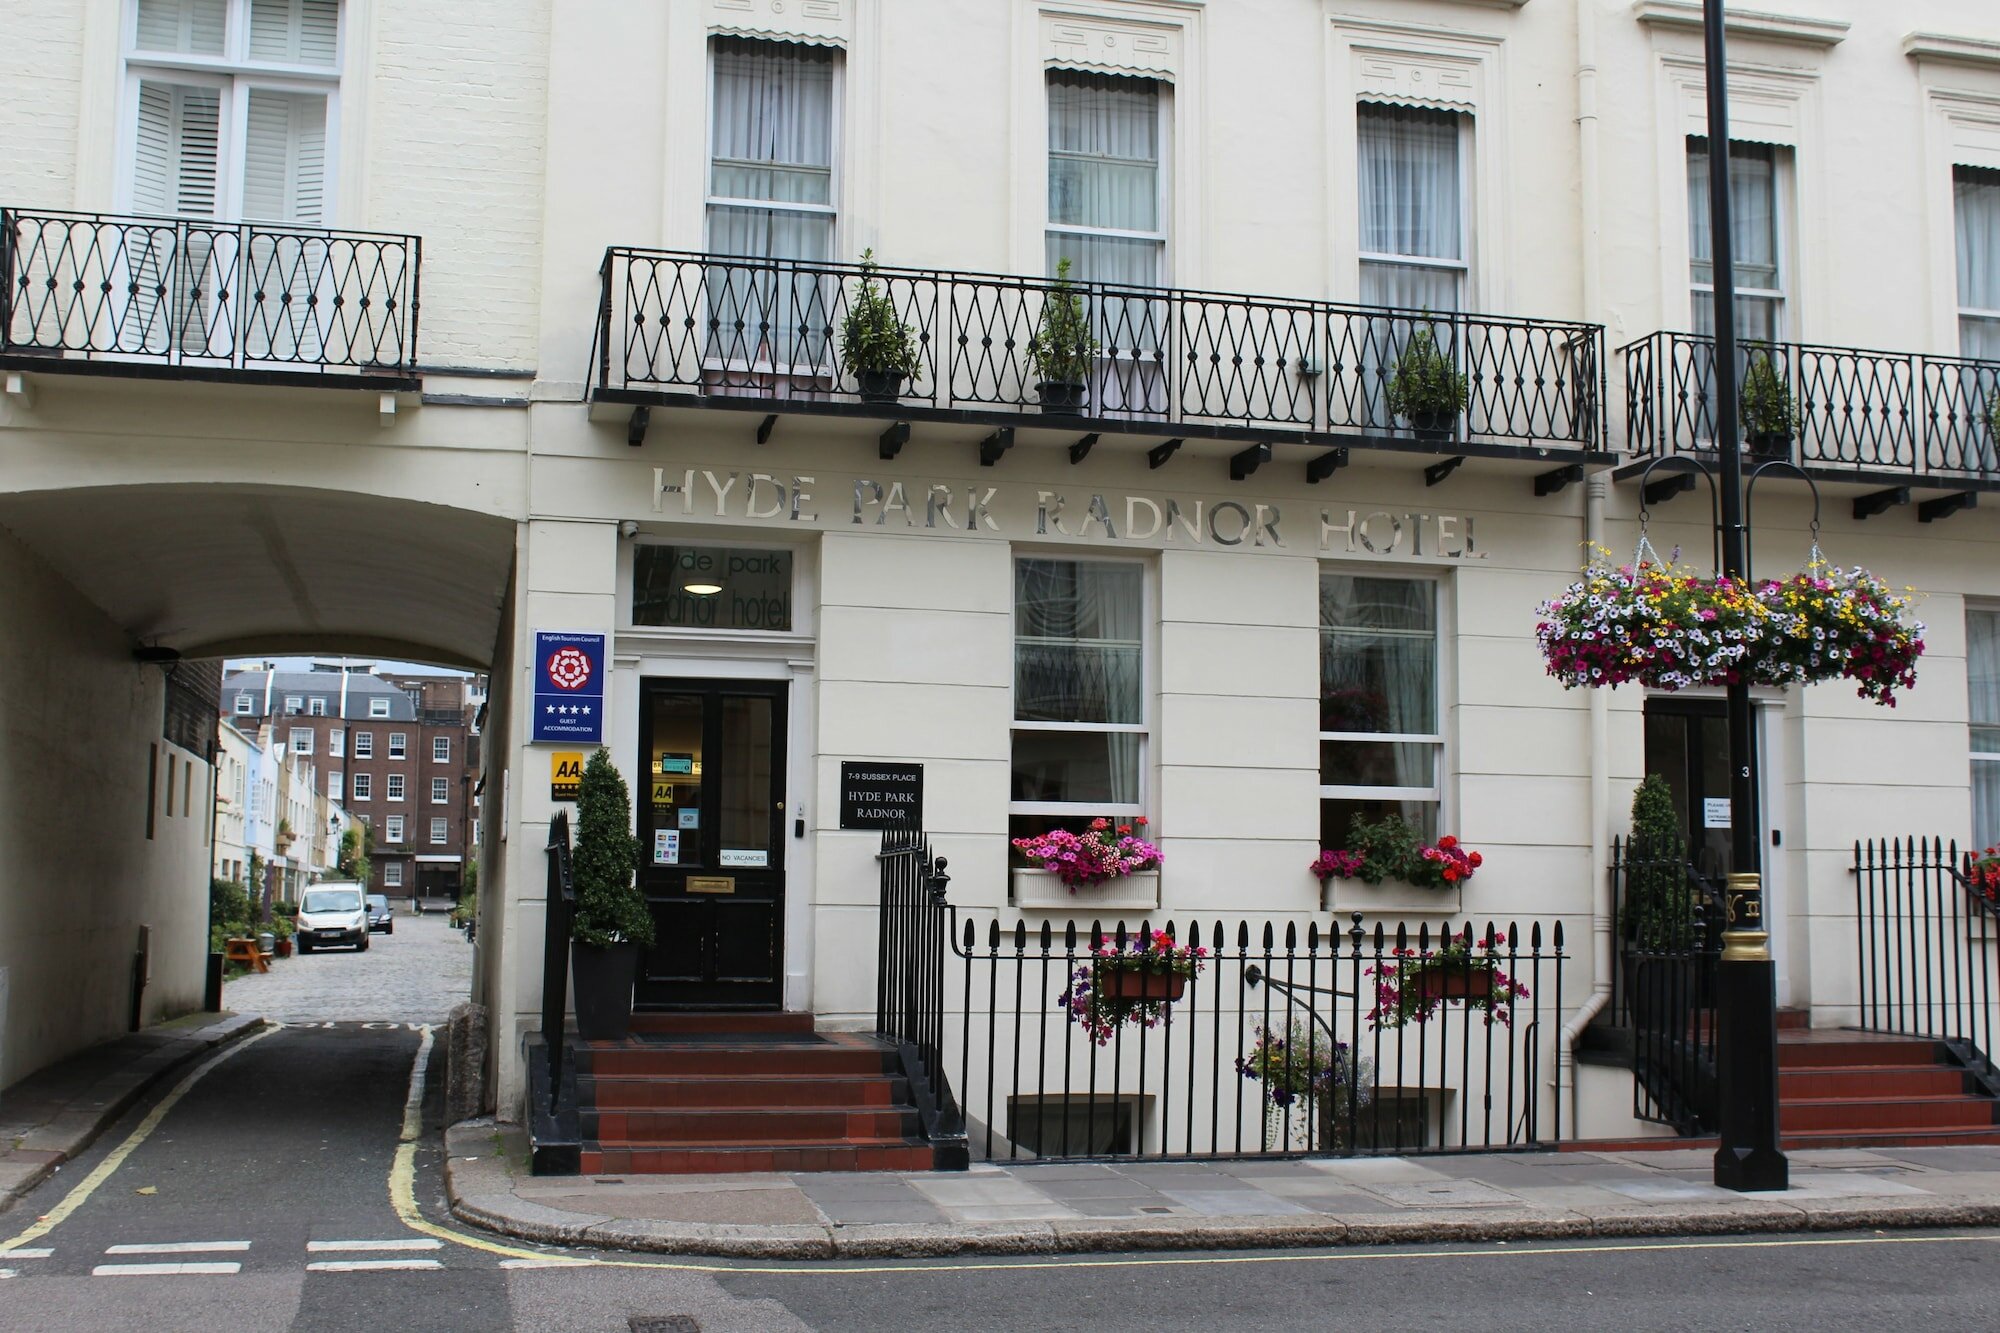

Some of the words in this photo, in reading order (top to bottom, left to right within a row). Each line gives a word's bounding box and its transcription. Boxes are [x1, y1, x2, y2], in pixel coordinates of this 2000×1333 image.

[651, 466, 818, 522] HYDE
[851, 479, 1001, 532] PARK
[1036, 489, 1287, 549] RADNOR
[1319, 508, 1490, 559] HOTEL
[729, 553, 782, 577] park
[732, 587, 788, 628] hotel
[542, 634, 561, 642] English
[561, 635, 580, 643] Tourism
[543, 725, 593, 733] ACCOMMODATION
[555, 760, 580, 778] AA
[1742, 766, 1749, 777] 3
[861, 773, 892, 781] SUSSEX
[892, 774, 917, 782] PLACE
[654, 785, 672, 799] AA
[848, 791, 882, 802] HYDE
[885, 792, 915, 803] PARK
[856, 808, 906, 819] RADNOR
